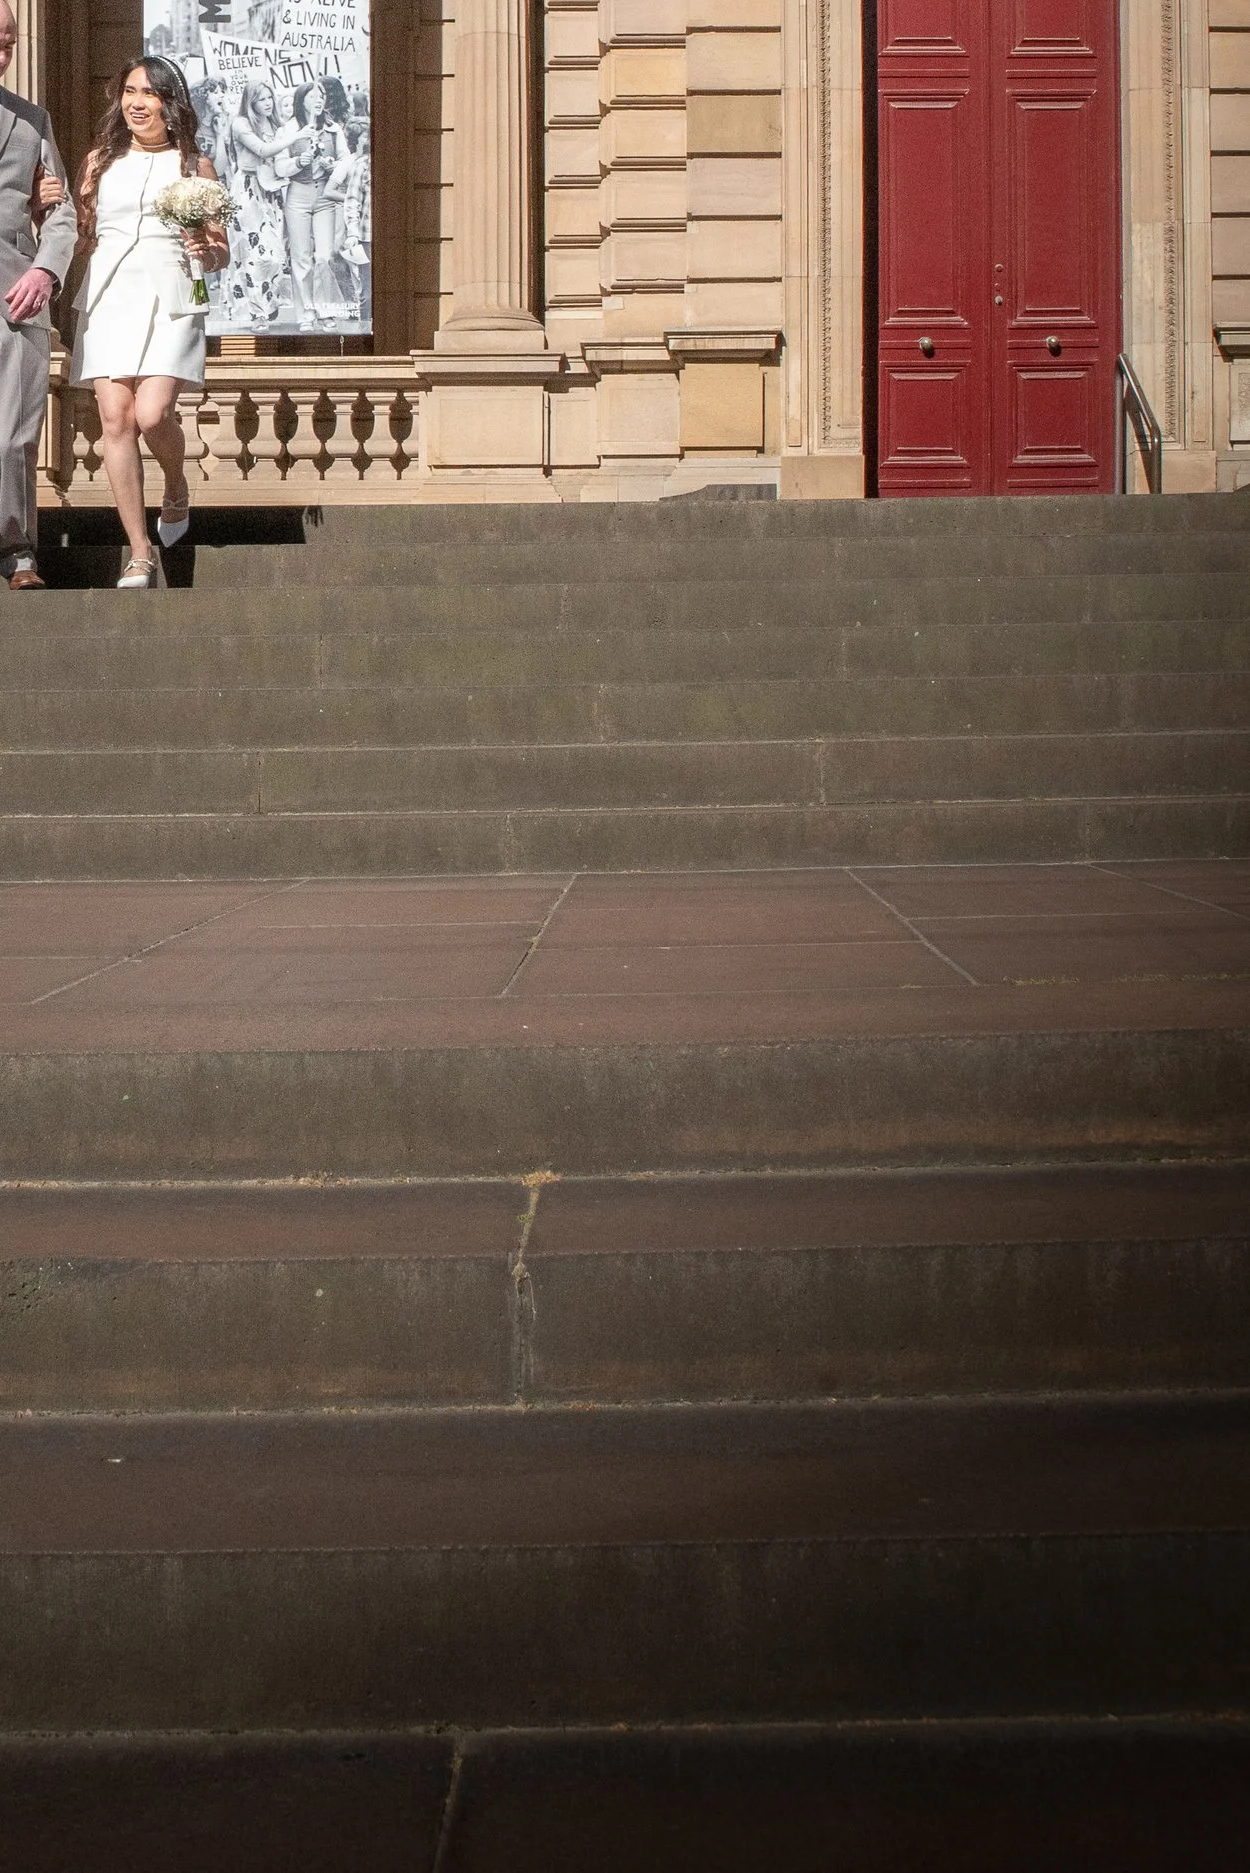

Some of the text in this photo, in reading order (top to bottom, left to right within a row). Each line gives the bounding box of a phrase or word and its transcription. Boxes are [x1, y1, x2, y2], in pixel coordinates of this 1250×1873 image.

[282, 9, 356, 30] & LIVING IN
[281, 31, 356, 53] AUSTRALIA
[218, 56, 263, 71] BELIEVE
